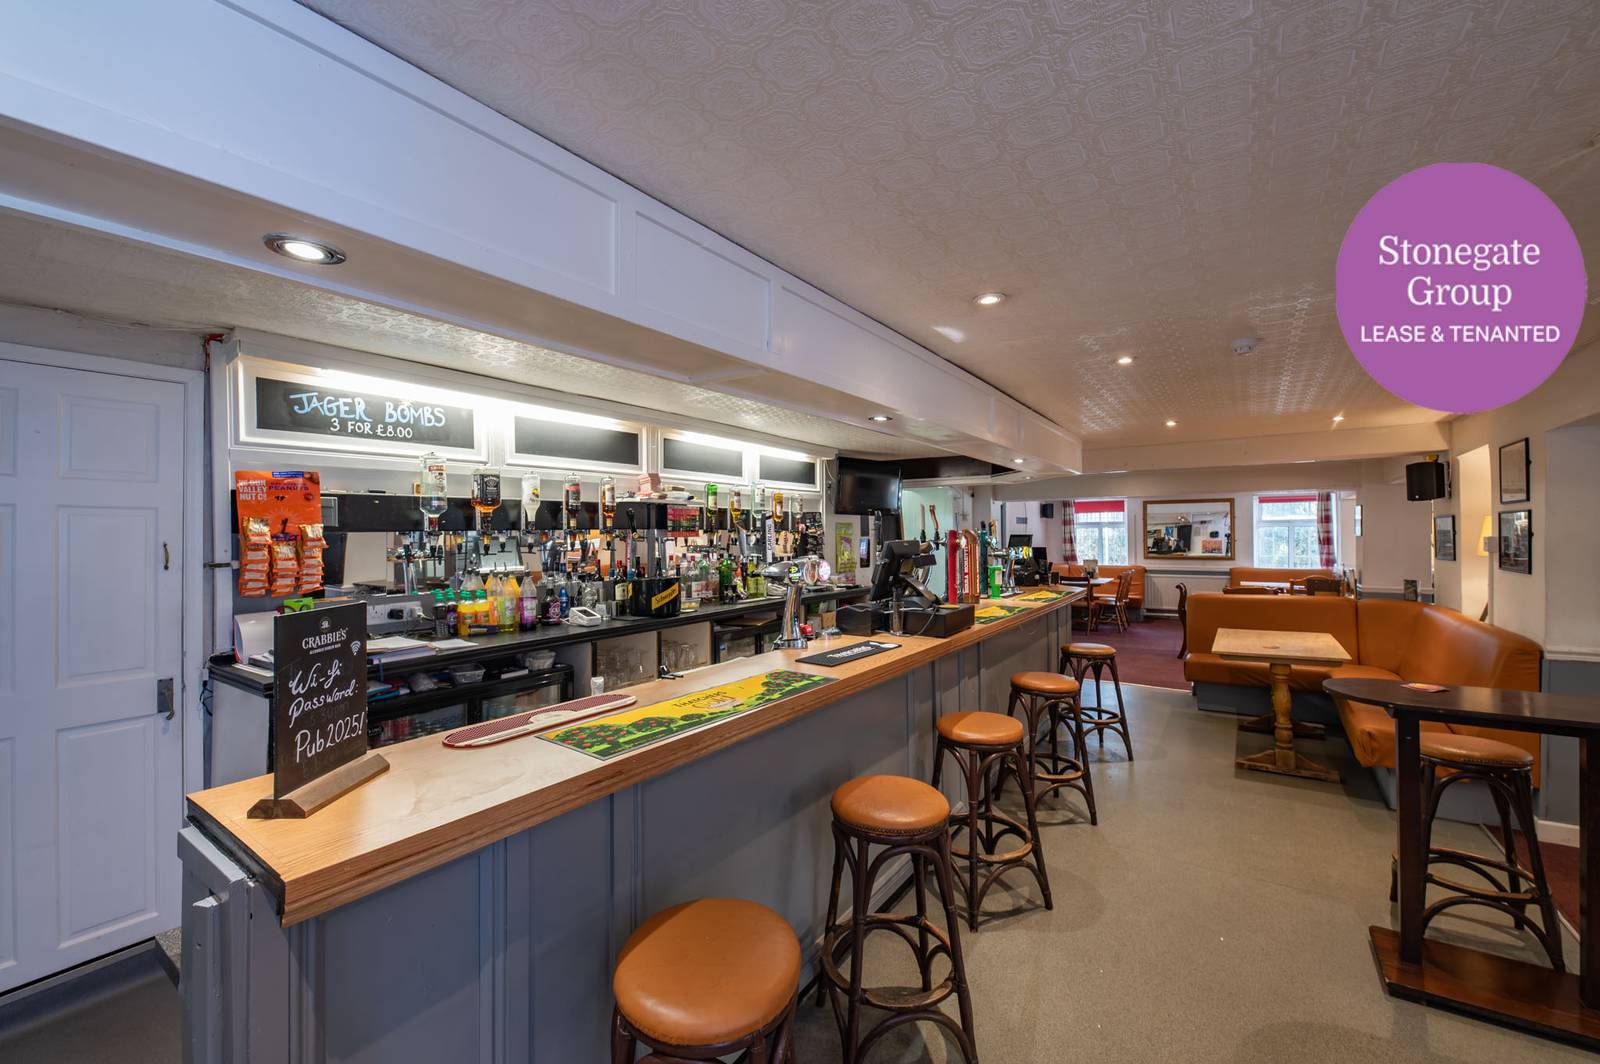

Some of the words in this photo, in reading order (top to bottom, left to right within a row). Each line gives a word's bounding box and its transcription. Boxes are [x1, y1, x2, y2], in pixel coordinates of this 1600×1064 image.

[289, 392, 373, 422] JAGER
[385, 400, 446, 427] BOMBS
[330, 418, 340, 431] 3
[348, 421, 373, 435] FOR
[376, 424, 413, 438] £8.00
[239, 485, 267, 493] VALLEY
[240, 493, 257, 501] NUT
[302, 628, 347, 649] CRABBIE'S
